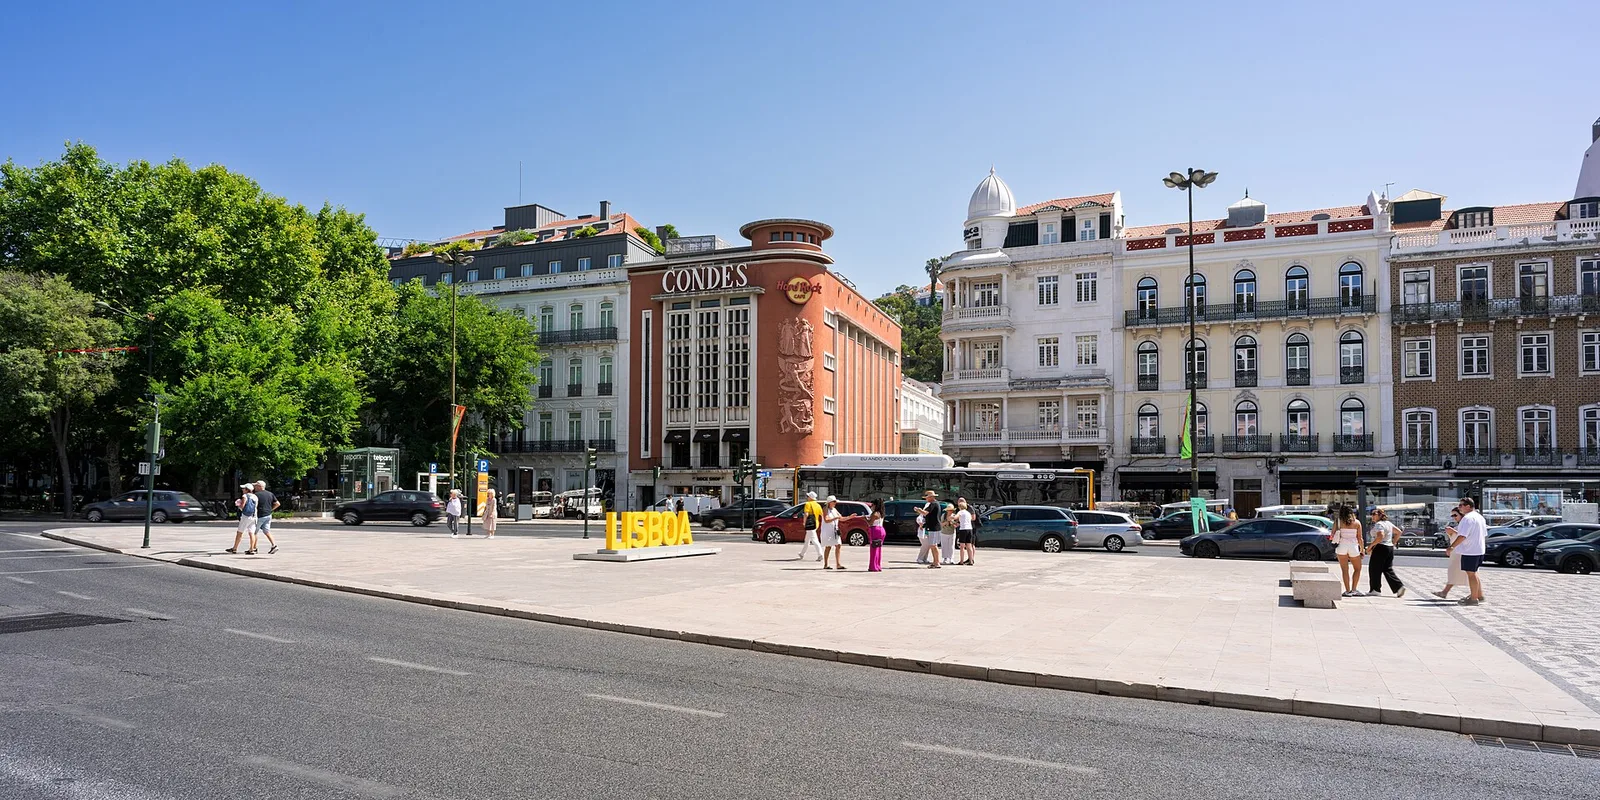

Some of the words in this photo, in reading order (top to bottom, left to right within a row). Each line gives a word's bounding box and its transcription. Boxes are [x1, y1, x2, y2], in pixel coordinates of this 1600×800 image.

[662, 263, 748, 293] CONDES
[776, 280, 800, 292] Hard
[800, 281, 822, 295] Rock
[373, 454, 393, 462] telpark
[480, 460, 488, 472] P
[606, 511, 694, 550] LISBOA
